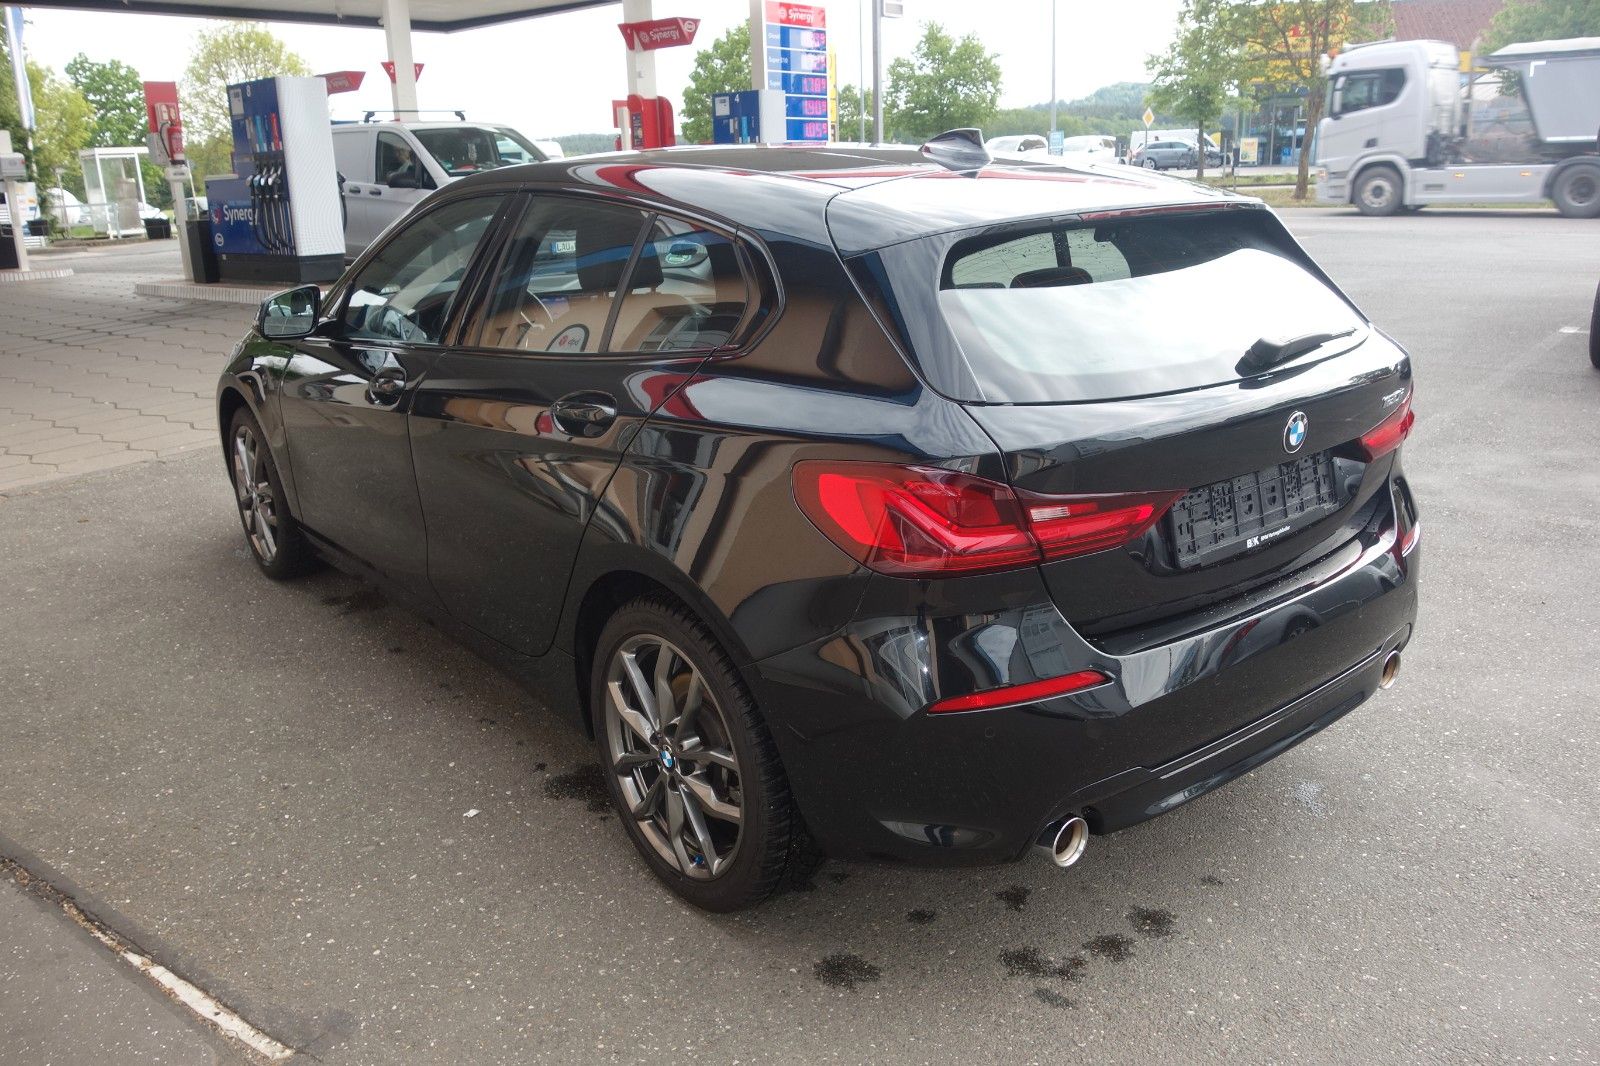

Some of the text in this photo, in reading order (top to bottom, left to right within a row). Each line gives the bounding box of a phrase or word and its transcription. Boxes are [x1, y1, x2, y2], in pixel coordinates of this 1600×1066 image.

[788, 9, 815, 23] Synergy
[649, 28, 680, 42] Synergy
[389, 65, 394, 73] 2
[246, 84, 252, 97] 8
[734, 94, 740, 103] 4
[223, 205, 259, 226] Synergy
